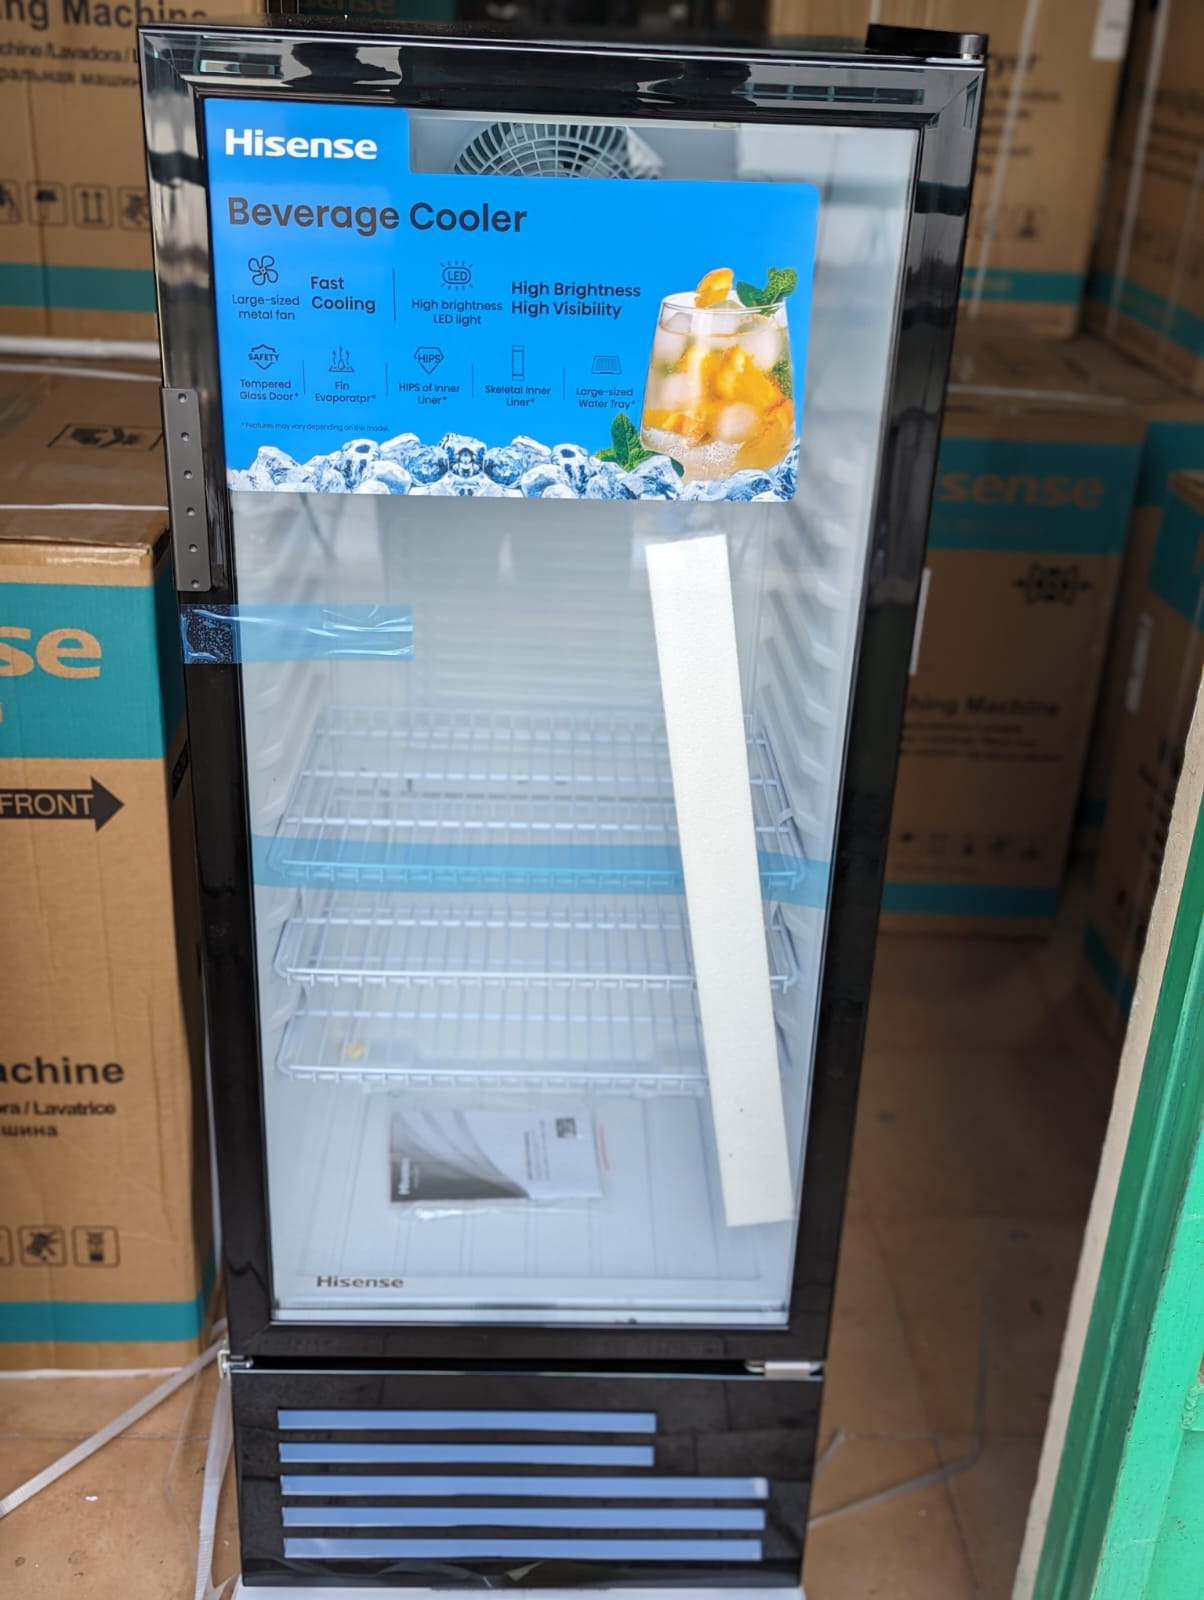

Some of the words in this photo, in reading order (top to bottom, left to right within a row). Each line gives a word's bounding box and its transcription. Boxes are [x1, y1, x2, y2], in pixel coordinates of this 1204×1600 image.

[0, 0, 49, 31] ng
[225, 128, 378, 160] Hisense
[228, 197, 399, 237] Beverage
[410, 202, 527, 232] Cooler
[447, 270, 468, 282] LED
[310, 276, 345, 290] Fast
[511, 281, 550, 299] High
[553, 282, 641, 300] Brightness
[232, 294, 300, 308] Large-sized
[311, 296, 377, 314] Cooling
[411, 299, 438, 312] High
[440, 299, 503, 313] brightness
[238, 309, 273, 320] metal
[275, 309, 296, 321] fan
[511, 301, 550, 319] High
[553, 302, 622, 320] Visibility
[433, 314, 453, 325] LED
[455, 314, 481, 327] light
[248, 353, 280, 362] SAFETY
[417, 353, 442, 364] HIPS
[240, 379, 291, 391] Tempered
[335, 381, 350, 390] Fin
[399, 383, 420, 393] HIPS
[422, 383, 433, 393] of
[435, 384, 461, 394] Inner
[485, 385, 523, 395] Skeletal
[525, 386, 551, 396] Inner
[240, 391, 268, 401] Glass
[576, 387, 634, 399] Large-sized
[578, 399, 609, 408] Water
[306, 424, 343, 432] depending
[939, 471, 1105, 509] sense
[0, 793, 95, 816] FRONT
[0, 1056, 124, 1084] chine
[316, 1274, 404, 1289] Hisense
